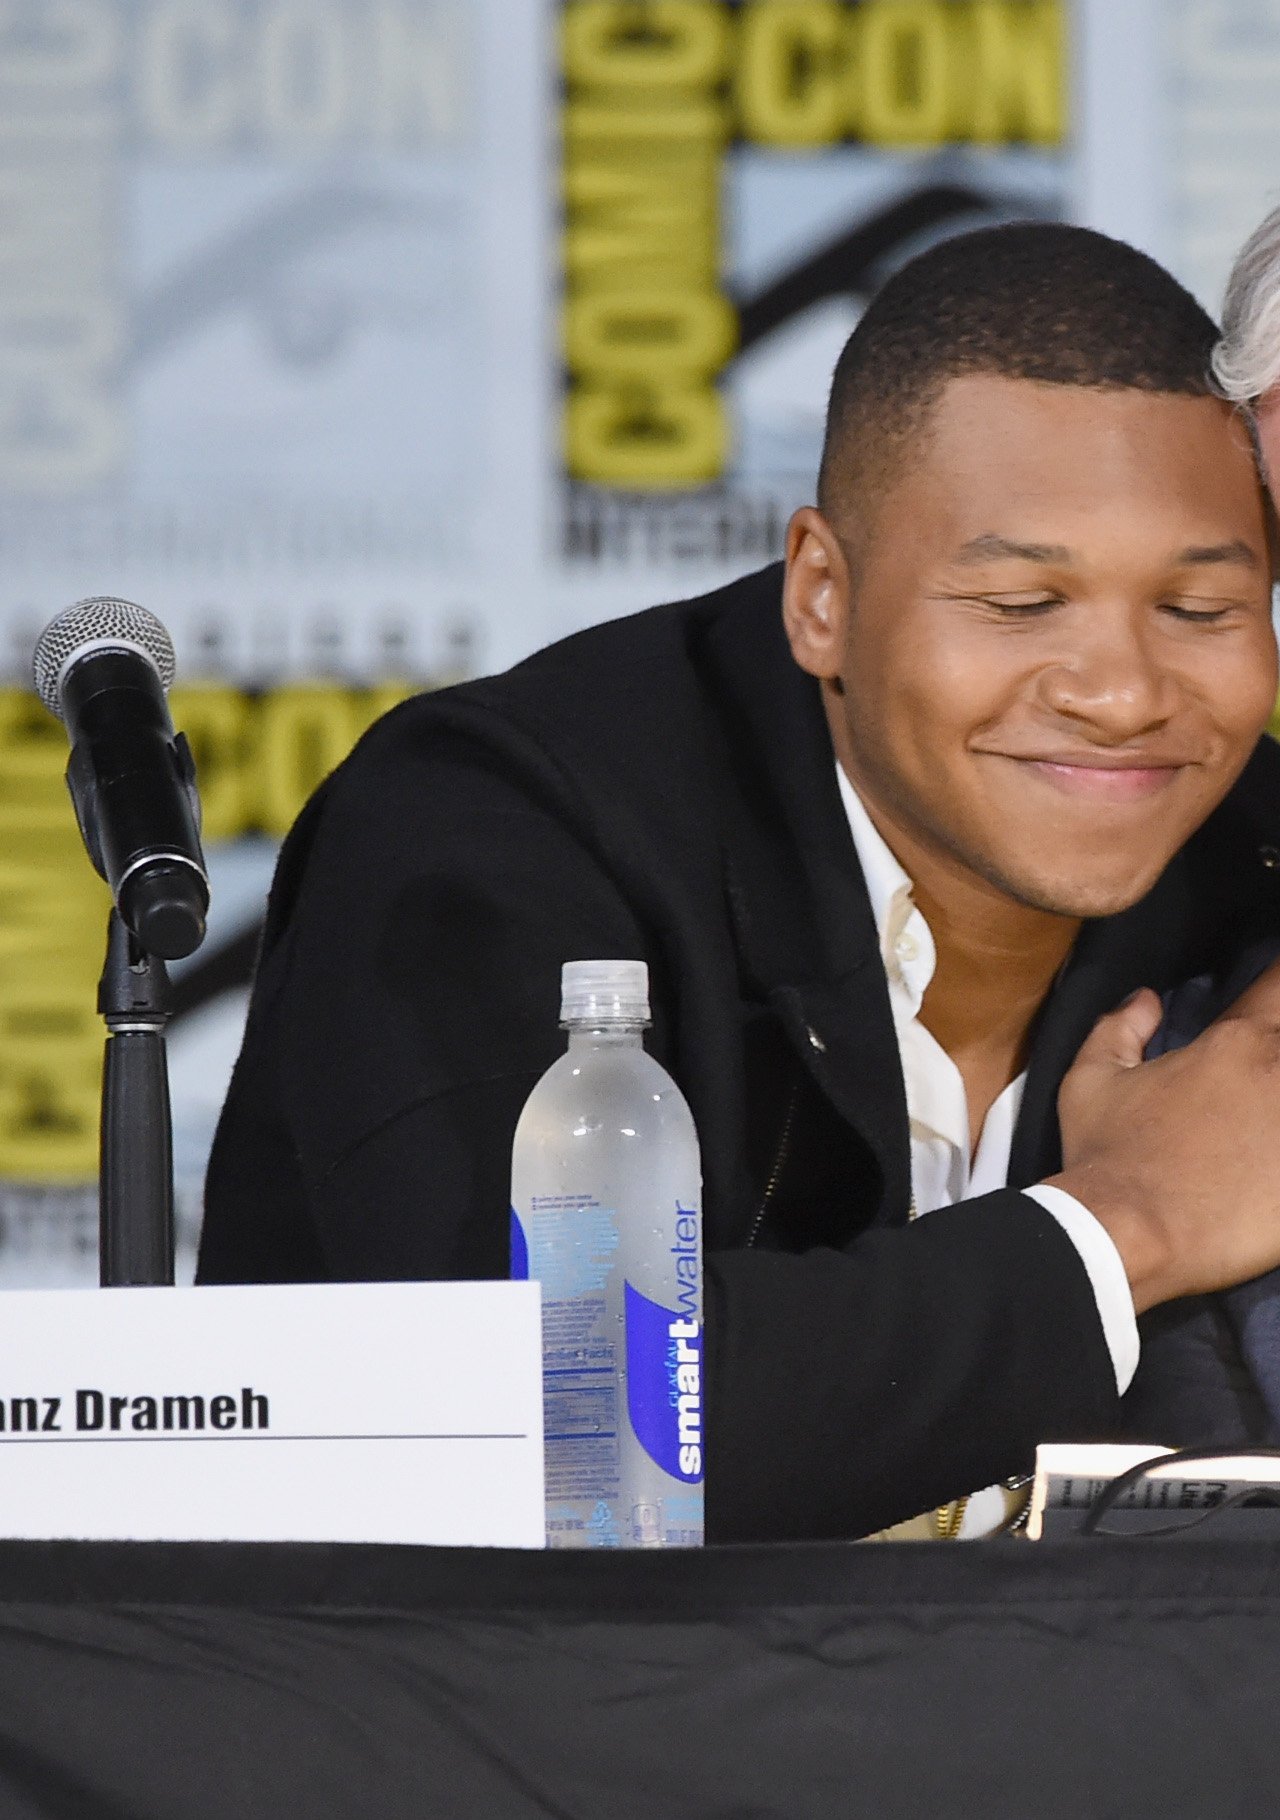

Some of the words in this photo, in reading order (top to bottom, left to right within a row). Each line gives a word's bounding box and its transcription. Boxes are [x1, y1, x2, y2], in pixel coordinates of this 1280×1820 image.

[738, 0, 1066, 148] CON
[0, 1397, 62, 1432] nz
[75, 1387, 269, 1432] Drameh
